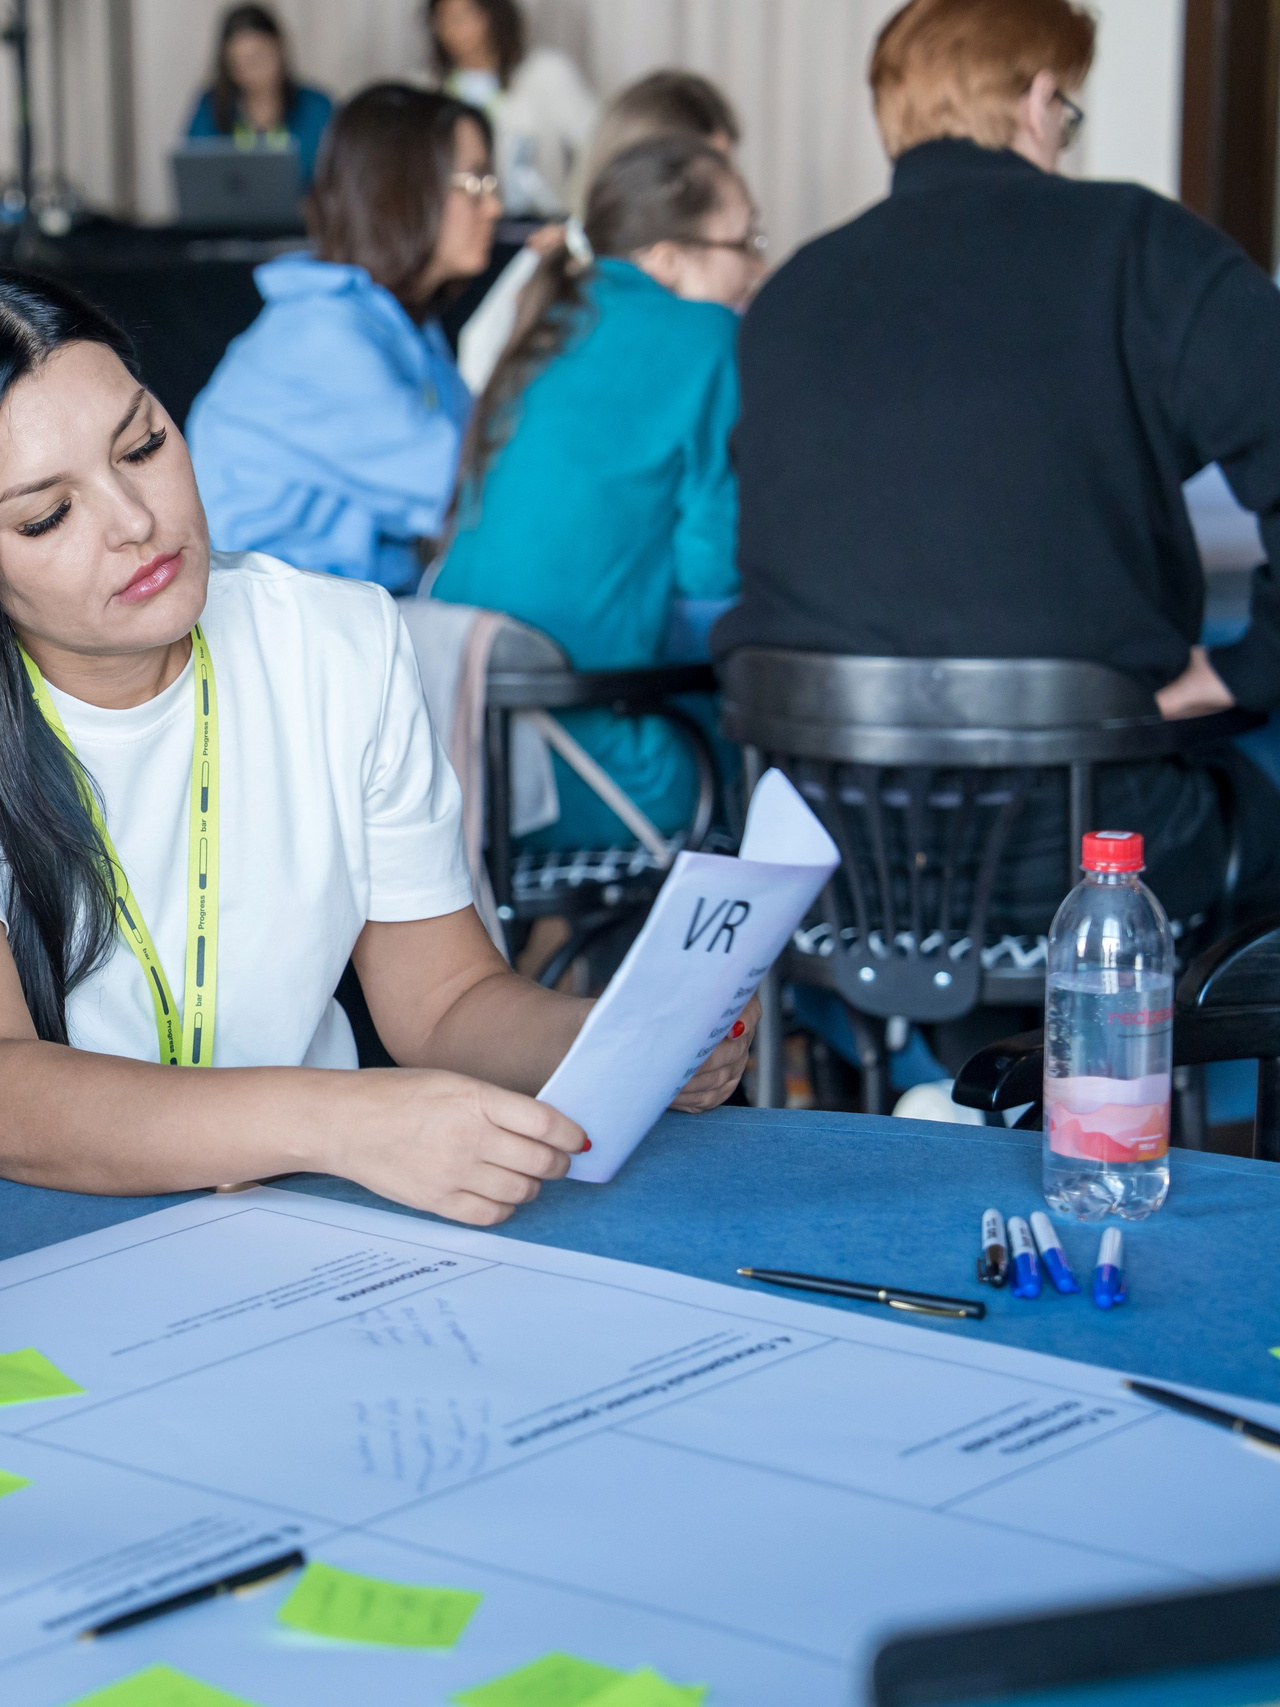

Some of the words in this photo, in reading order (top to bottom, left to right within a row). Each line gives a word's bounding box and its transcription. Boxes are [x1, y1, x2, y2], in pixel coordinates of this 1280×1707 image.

[198, 895, 206, 929] Progress
[683, 897, 750, 953] VR
[166, 1020, 174, 1053] Progress
